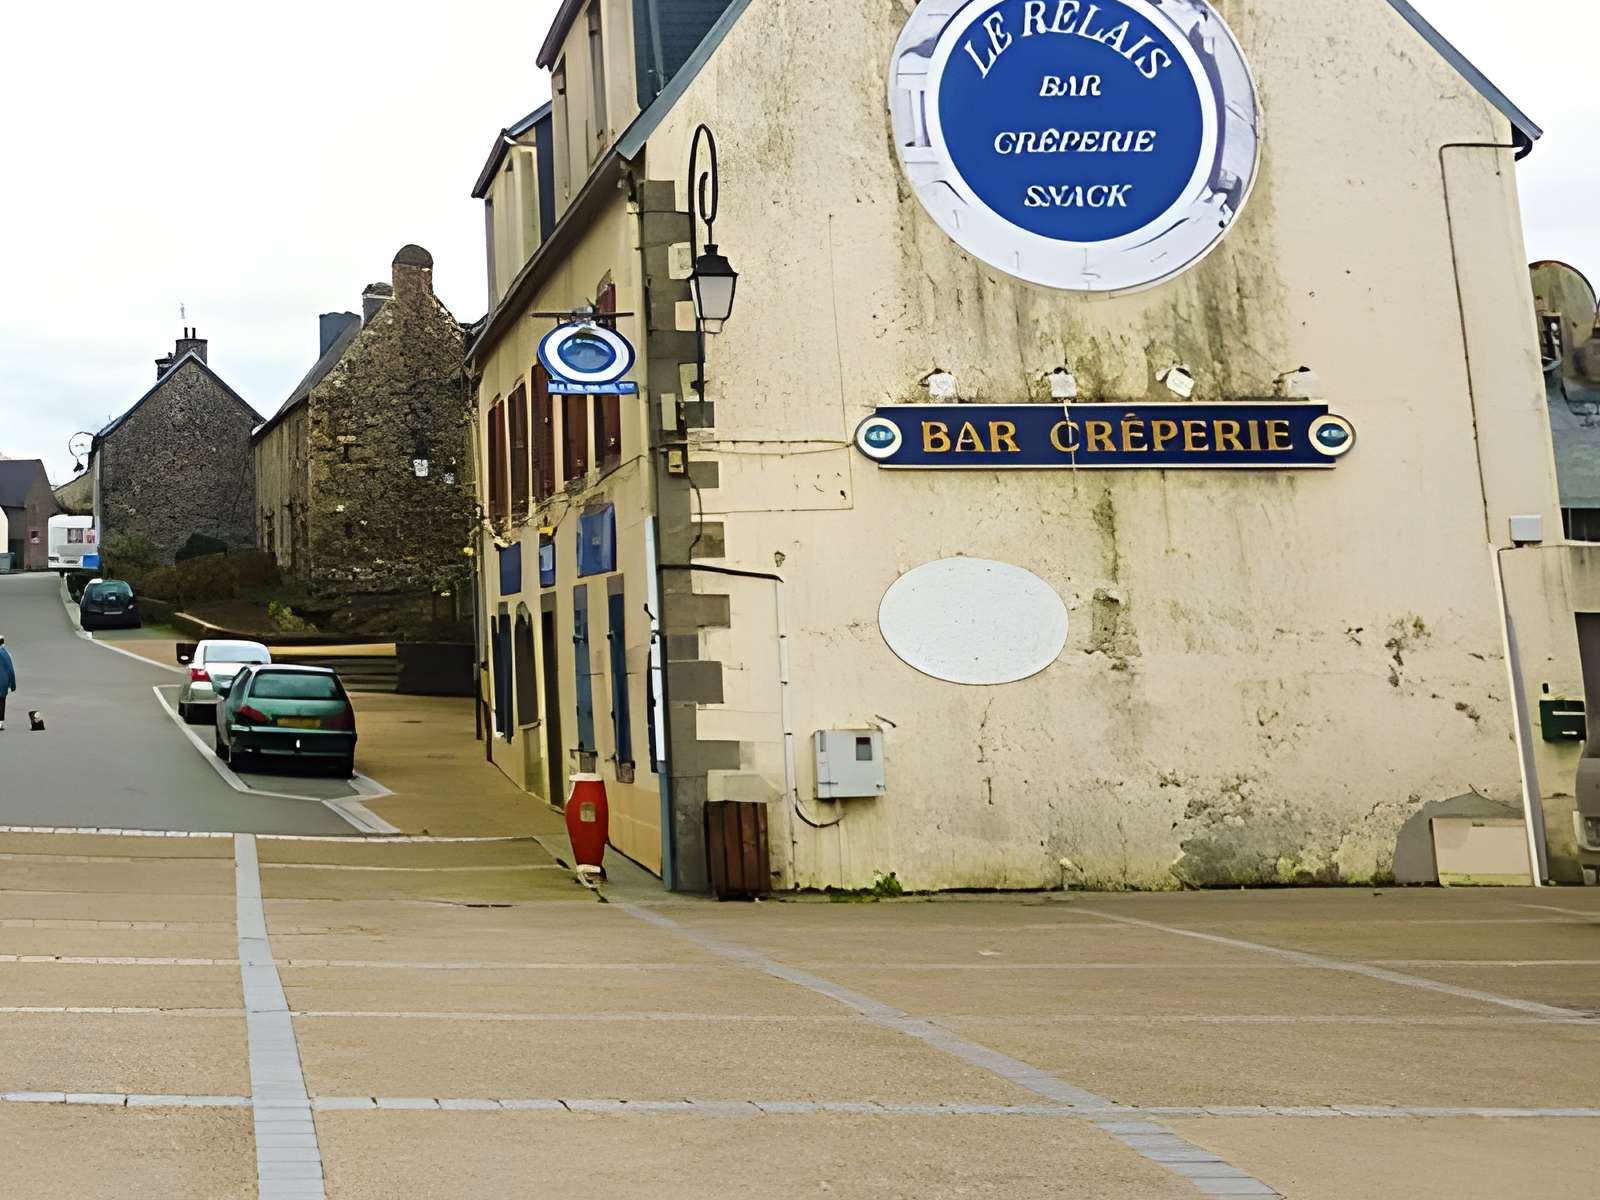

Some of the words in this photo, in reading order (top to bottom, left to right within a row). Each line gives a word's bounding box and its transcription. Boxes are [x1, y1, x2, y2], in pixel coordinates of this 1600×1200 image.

[964, 10, 1013, 79] LE
[1021, 0, 1172, 79] RELAIS
[1039, 74, 1102, 97] BAR
[1023, 184, 1133, 208] SNACK
[921, 420, 1022, 452] BAR
[1049, 413, 1293, 452] CRÊPERIE
